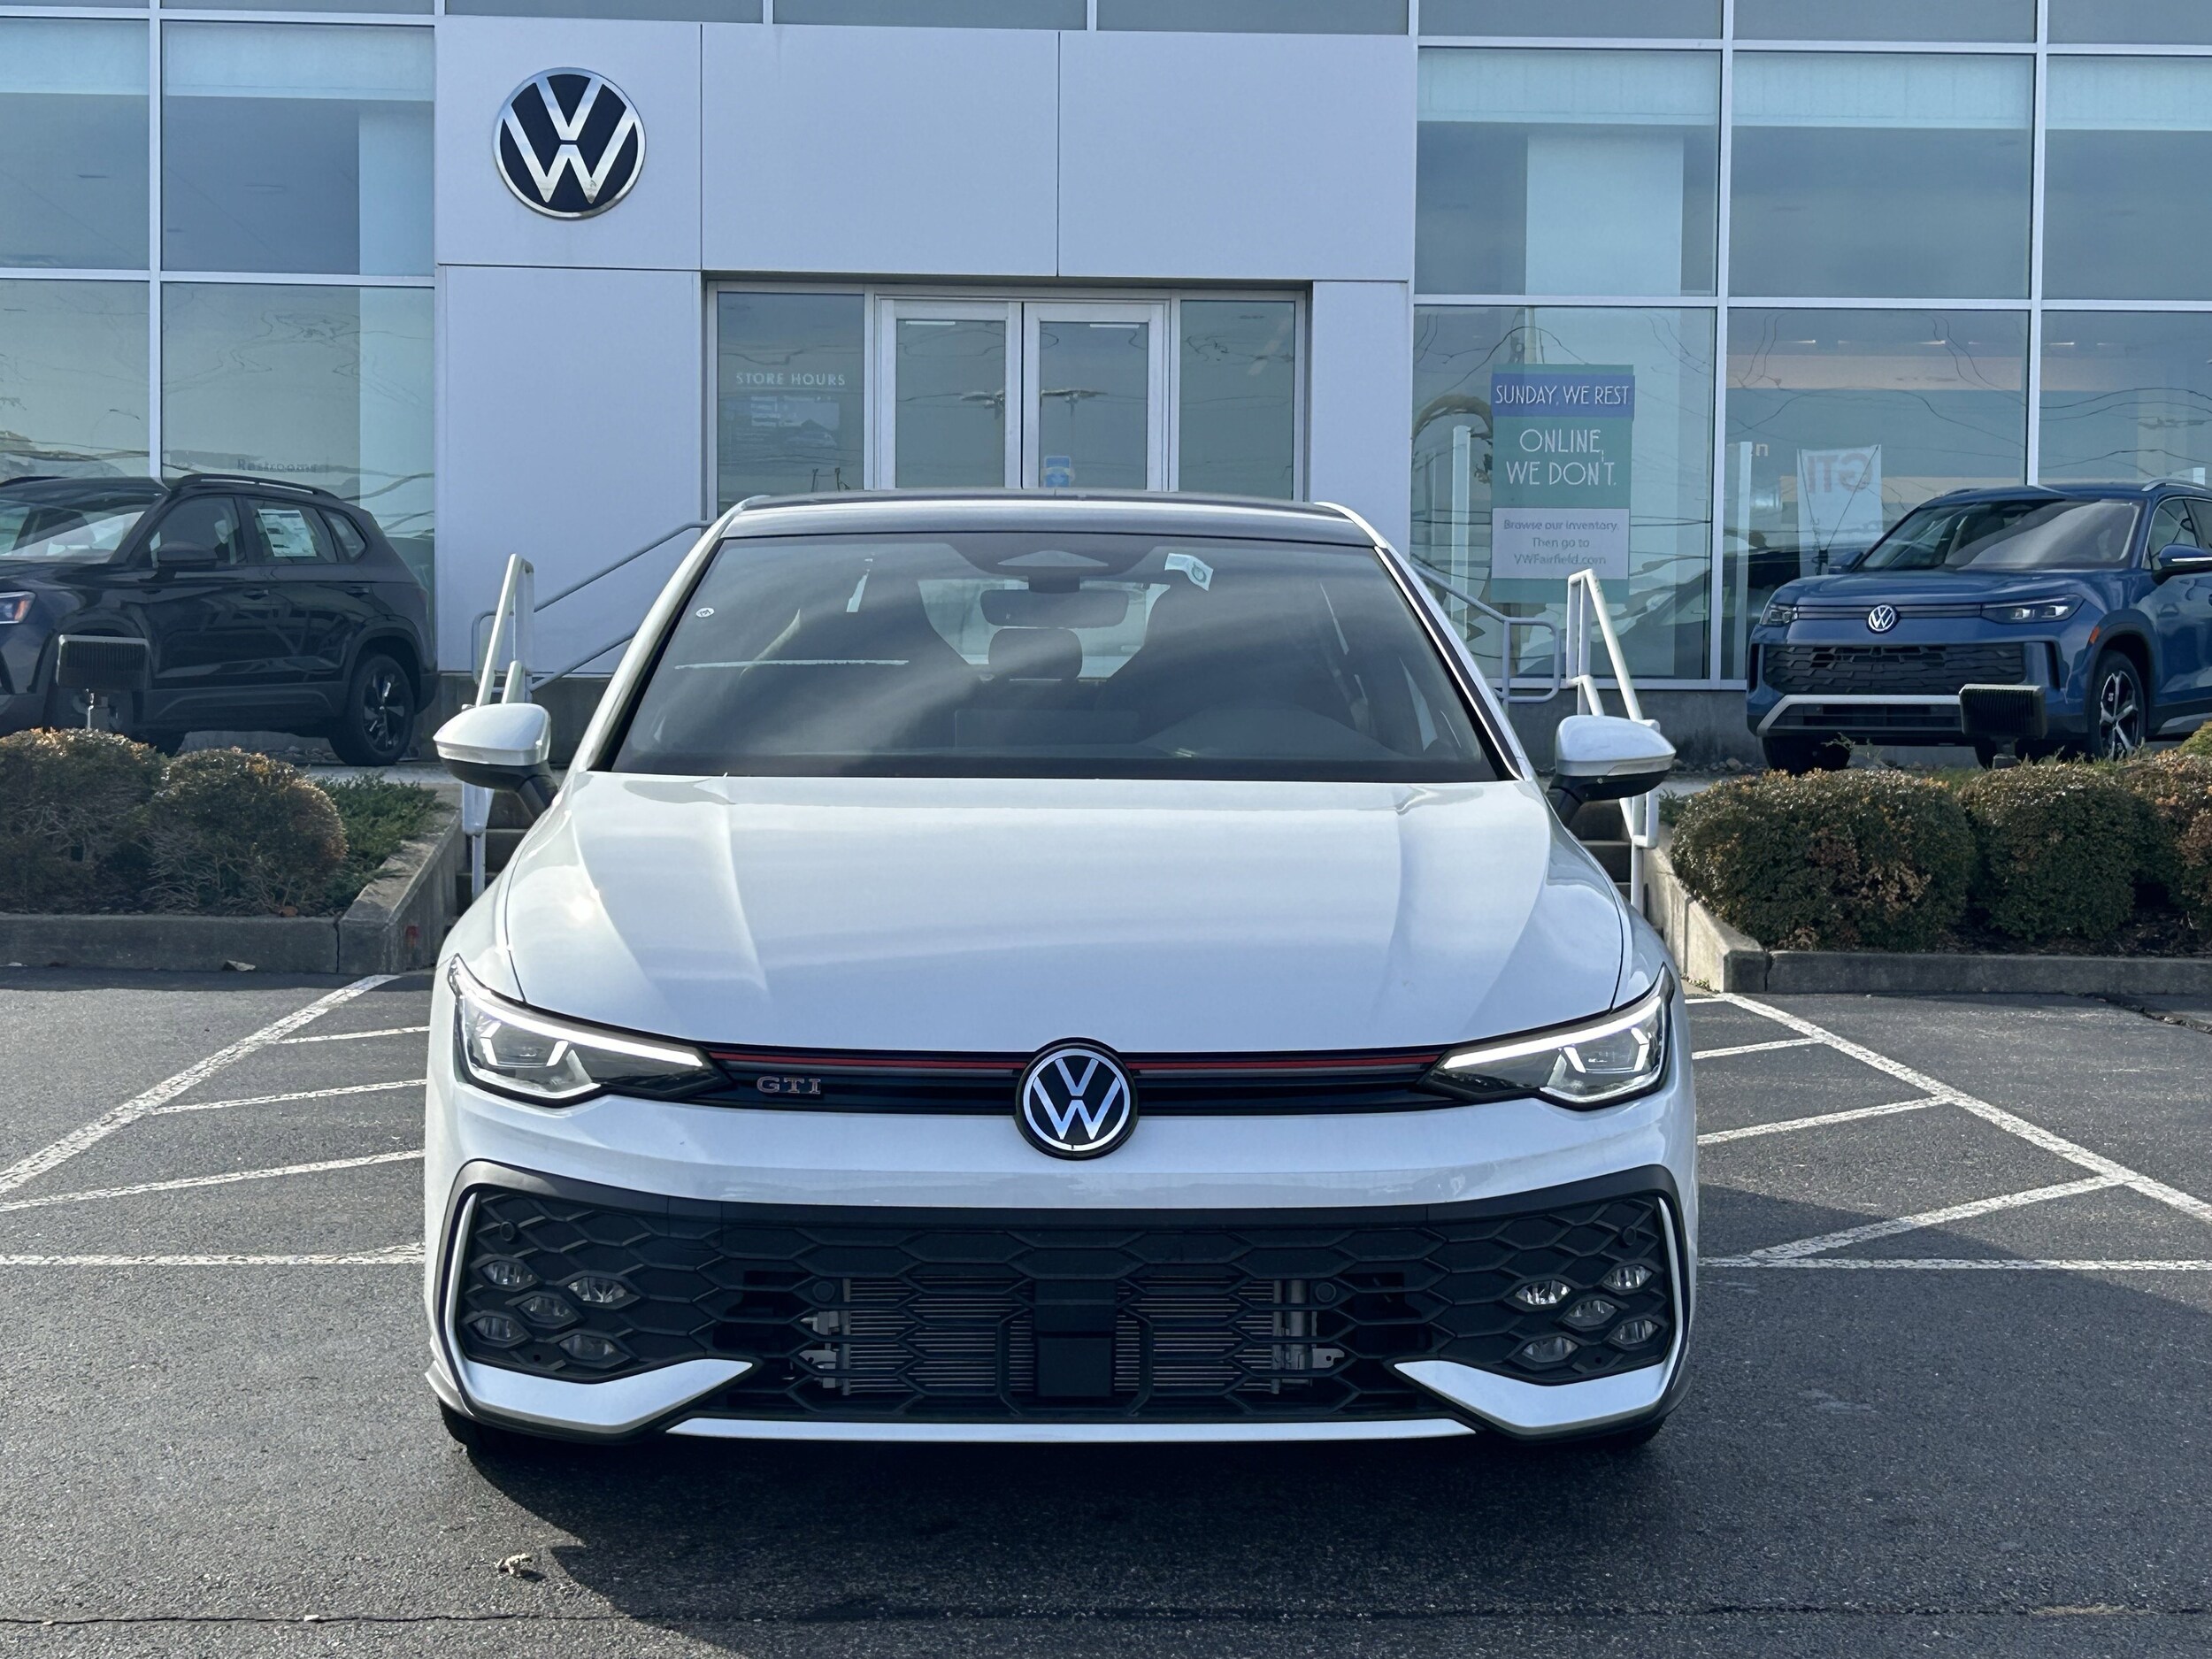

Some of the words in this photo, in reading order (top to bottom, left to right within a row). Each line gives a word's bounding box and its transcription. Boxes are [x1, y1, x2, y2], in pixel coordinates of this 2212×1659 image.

[498, 73, 640, 205] VW
[736, 373, 784, 384] STORE
[791, 373, 846, 386] HOURS
[1495, 385, 1559, 405] SUNDAY,
[1563, 385, 1590, 404] WE
[1594, 386, 1630, 404] REST
[1519, 428, 1604, 455] ONLINE,
[1506, 461, 1540, 485] WE
[1549, 457, 1617, 486] DON'T.
[1504, 519, 1542, 530] Browse
[1545, 521, 1563, 530] our
[1532, 537, 1559, 548] Then
[1561, 539, 1576, 550] go
[1578, 539, 1590, 548] to
[1514, 554, 1606, 565] VWFairfield.com
[1870, 605, 1894, 630] VW
[757, 1076, 821, 1094] GTI
[1028, 1053, 1125, 1145] VW
